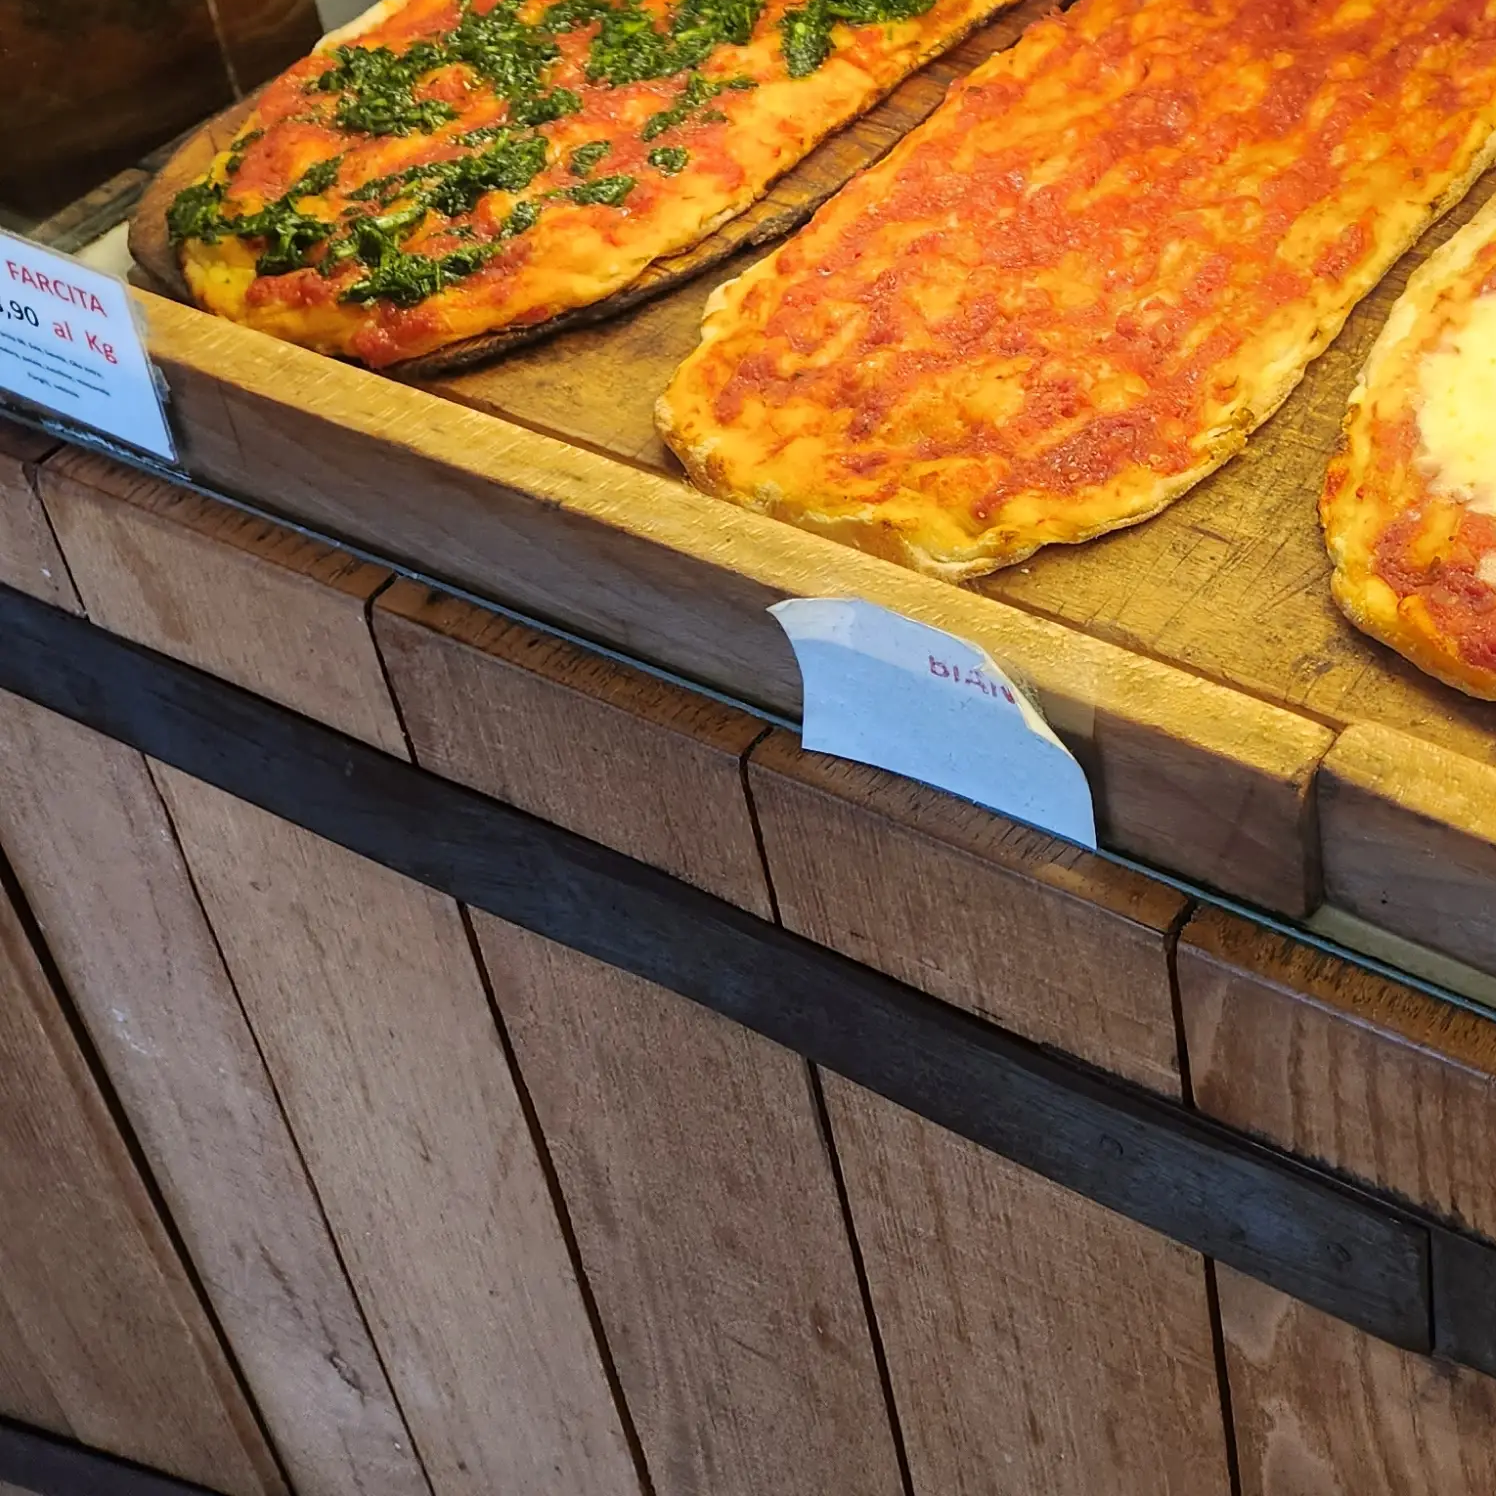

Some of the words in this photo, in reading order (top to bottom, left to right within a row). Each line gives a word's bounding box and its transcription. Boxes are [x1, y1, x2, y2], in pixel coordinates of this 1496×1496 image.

[6, 259, 108, 318] FARCITA
[0, 298, 39, 327] ,90
[52, 321, 73, 342] al
[84, 329, 118, 364] Kg
